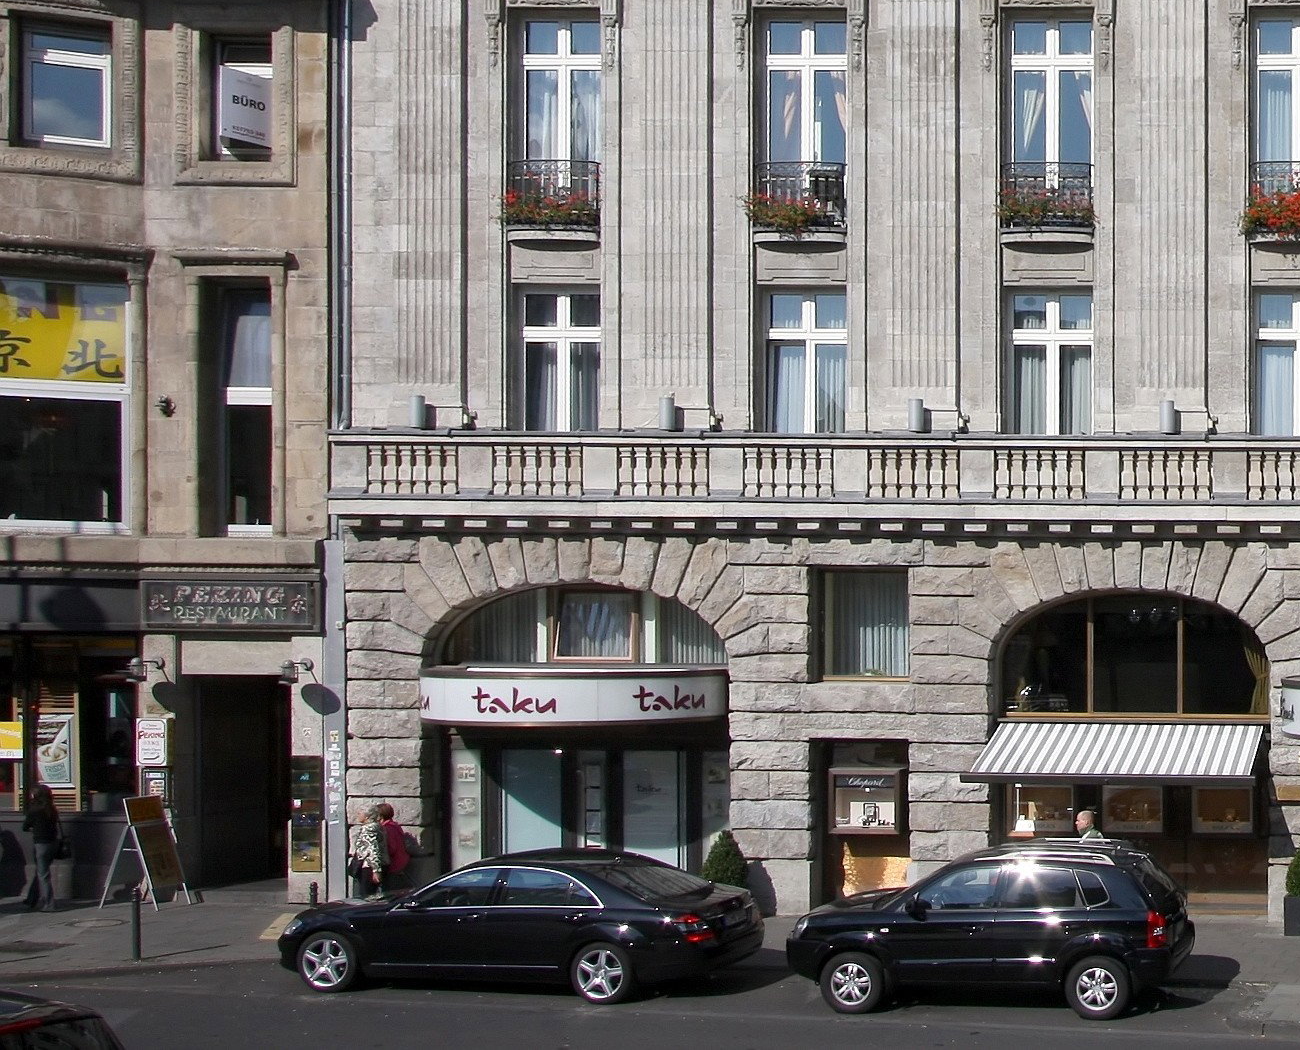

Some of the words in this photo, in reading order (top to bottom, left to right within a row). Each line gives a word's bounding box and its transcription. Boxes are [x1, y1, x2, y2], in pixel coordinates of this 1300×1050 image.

[232, 94, 266, 111] BÜRO
[173, 585, 286, 604] PEKING
[173, 605, 287, 621] RESTAURANT
[471, 686, 557, 714] taku
[633, 684, 706, 712] taku
[846, 777, 885, 789] Chopard
